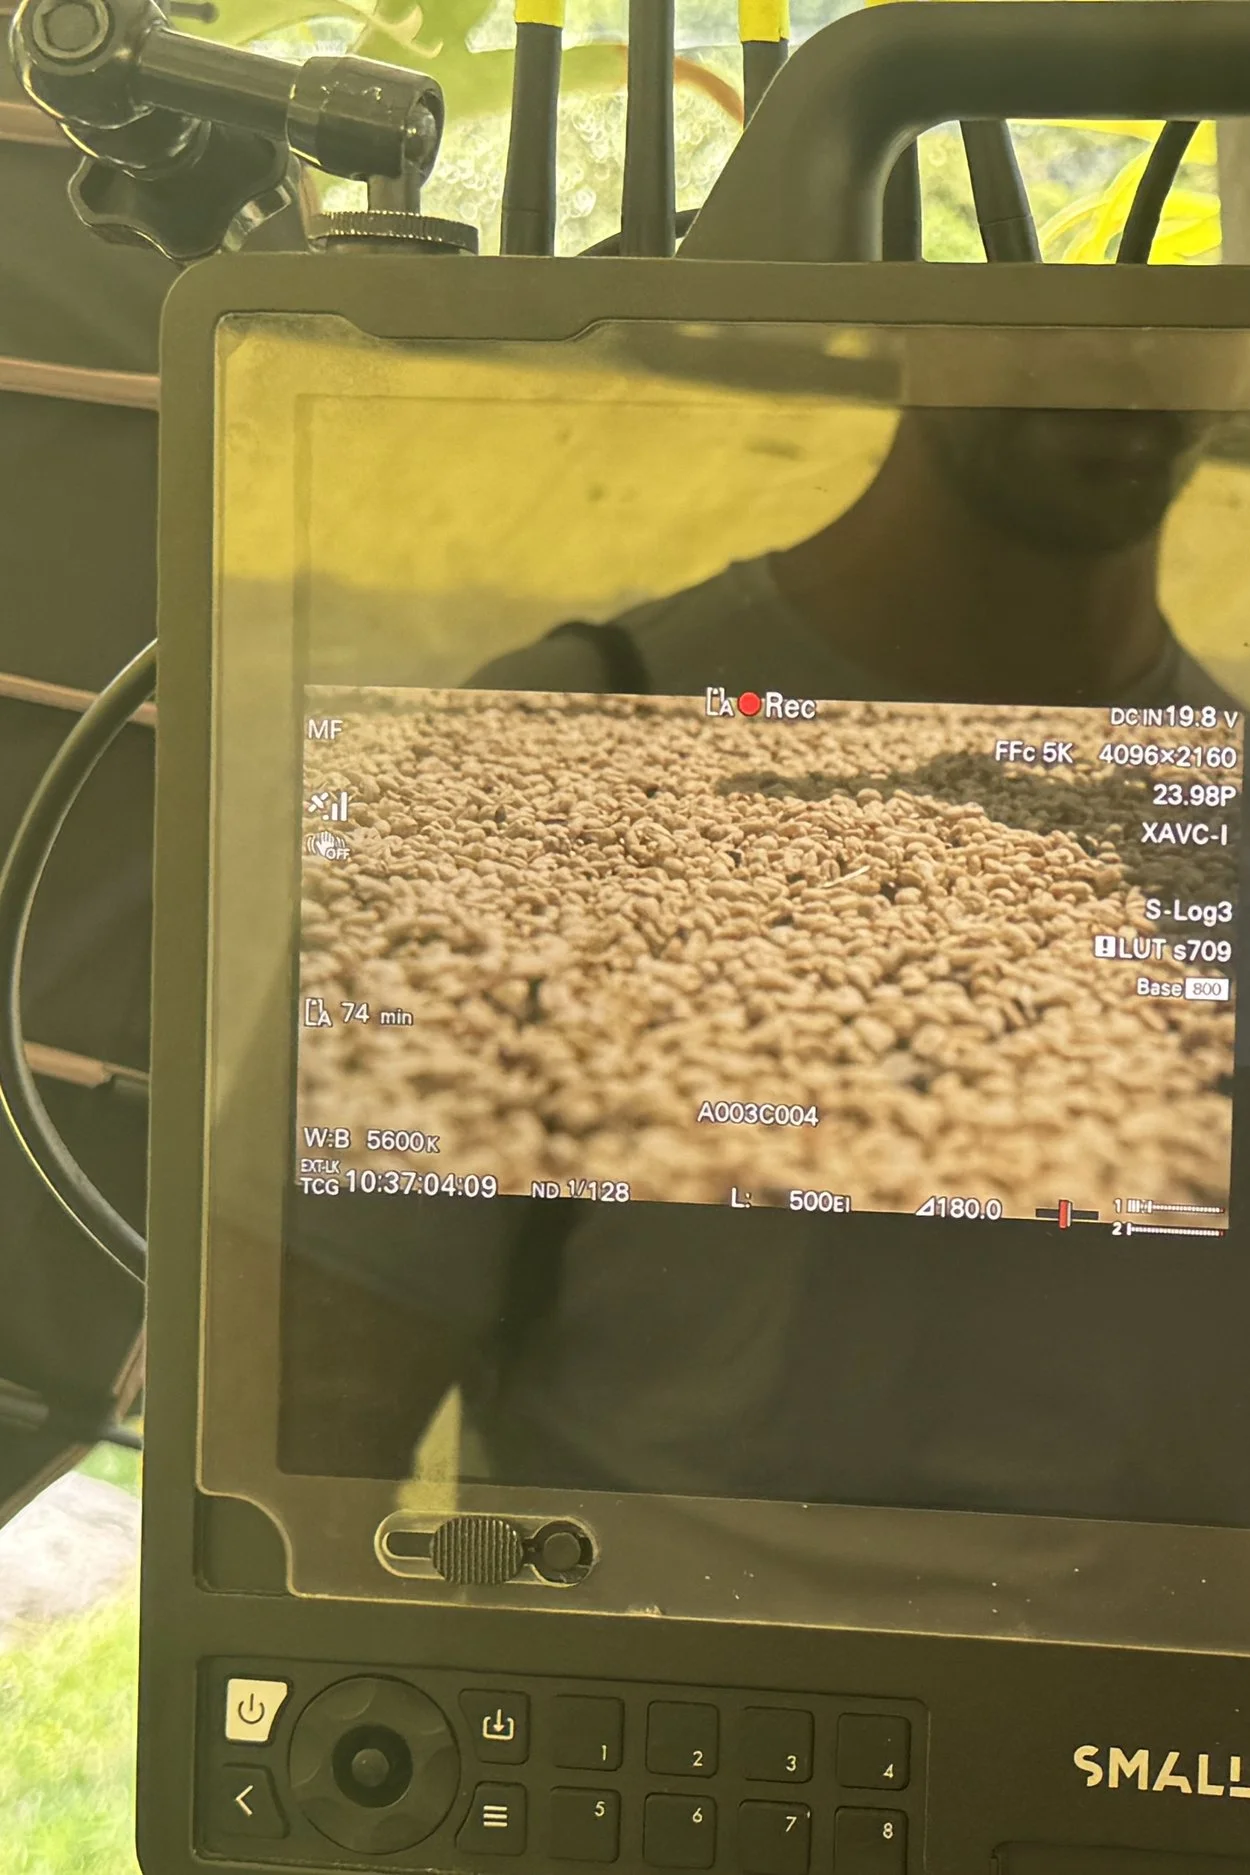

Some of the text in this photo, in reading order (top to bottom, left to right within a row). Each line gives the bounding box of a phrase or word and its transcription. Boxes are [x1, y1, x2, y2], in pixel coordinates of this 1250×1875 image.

[765, 691, 817, 719] Rec
[307, 719, 343, 740] MF
[1223, 711, 1239, 729] V
[995, 740, 1074, 764] FFc 5K
[1152, 784, 1238, 808] 23.98P
[1140, 821, 1229, 846] XAVC-I
[1145, 898, 1233, 928] S-Log3
[1119, 936, 1232, 963] LUT s709
[1136, 977, 1222, 997] Base 800
[342, 1002, 369, 1024] 74
[380, 1009, 413, 1027] min
[697, 1102, 819, 1127] A003C004
[300, 1169, 498, 1200] TCG 10:37:04:09
[531, 1179, 630, 1203] ND 1/128
[1112, 1222, 1123, 1237] 2
[601, 1744, 608, 1761] 1
[692, 1751, 703, 1767] 2
[786, 1755, 797, 1772] 3
[882, 1763, 895, 1780] 4
[594, 1801, 606, 1818] 5
[692, 1808, 703, 1824] 6
[785, 1816, 797, 1832] 7
[882, 1822, 893, 1840] 8
